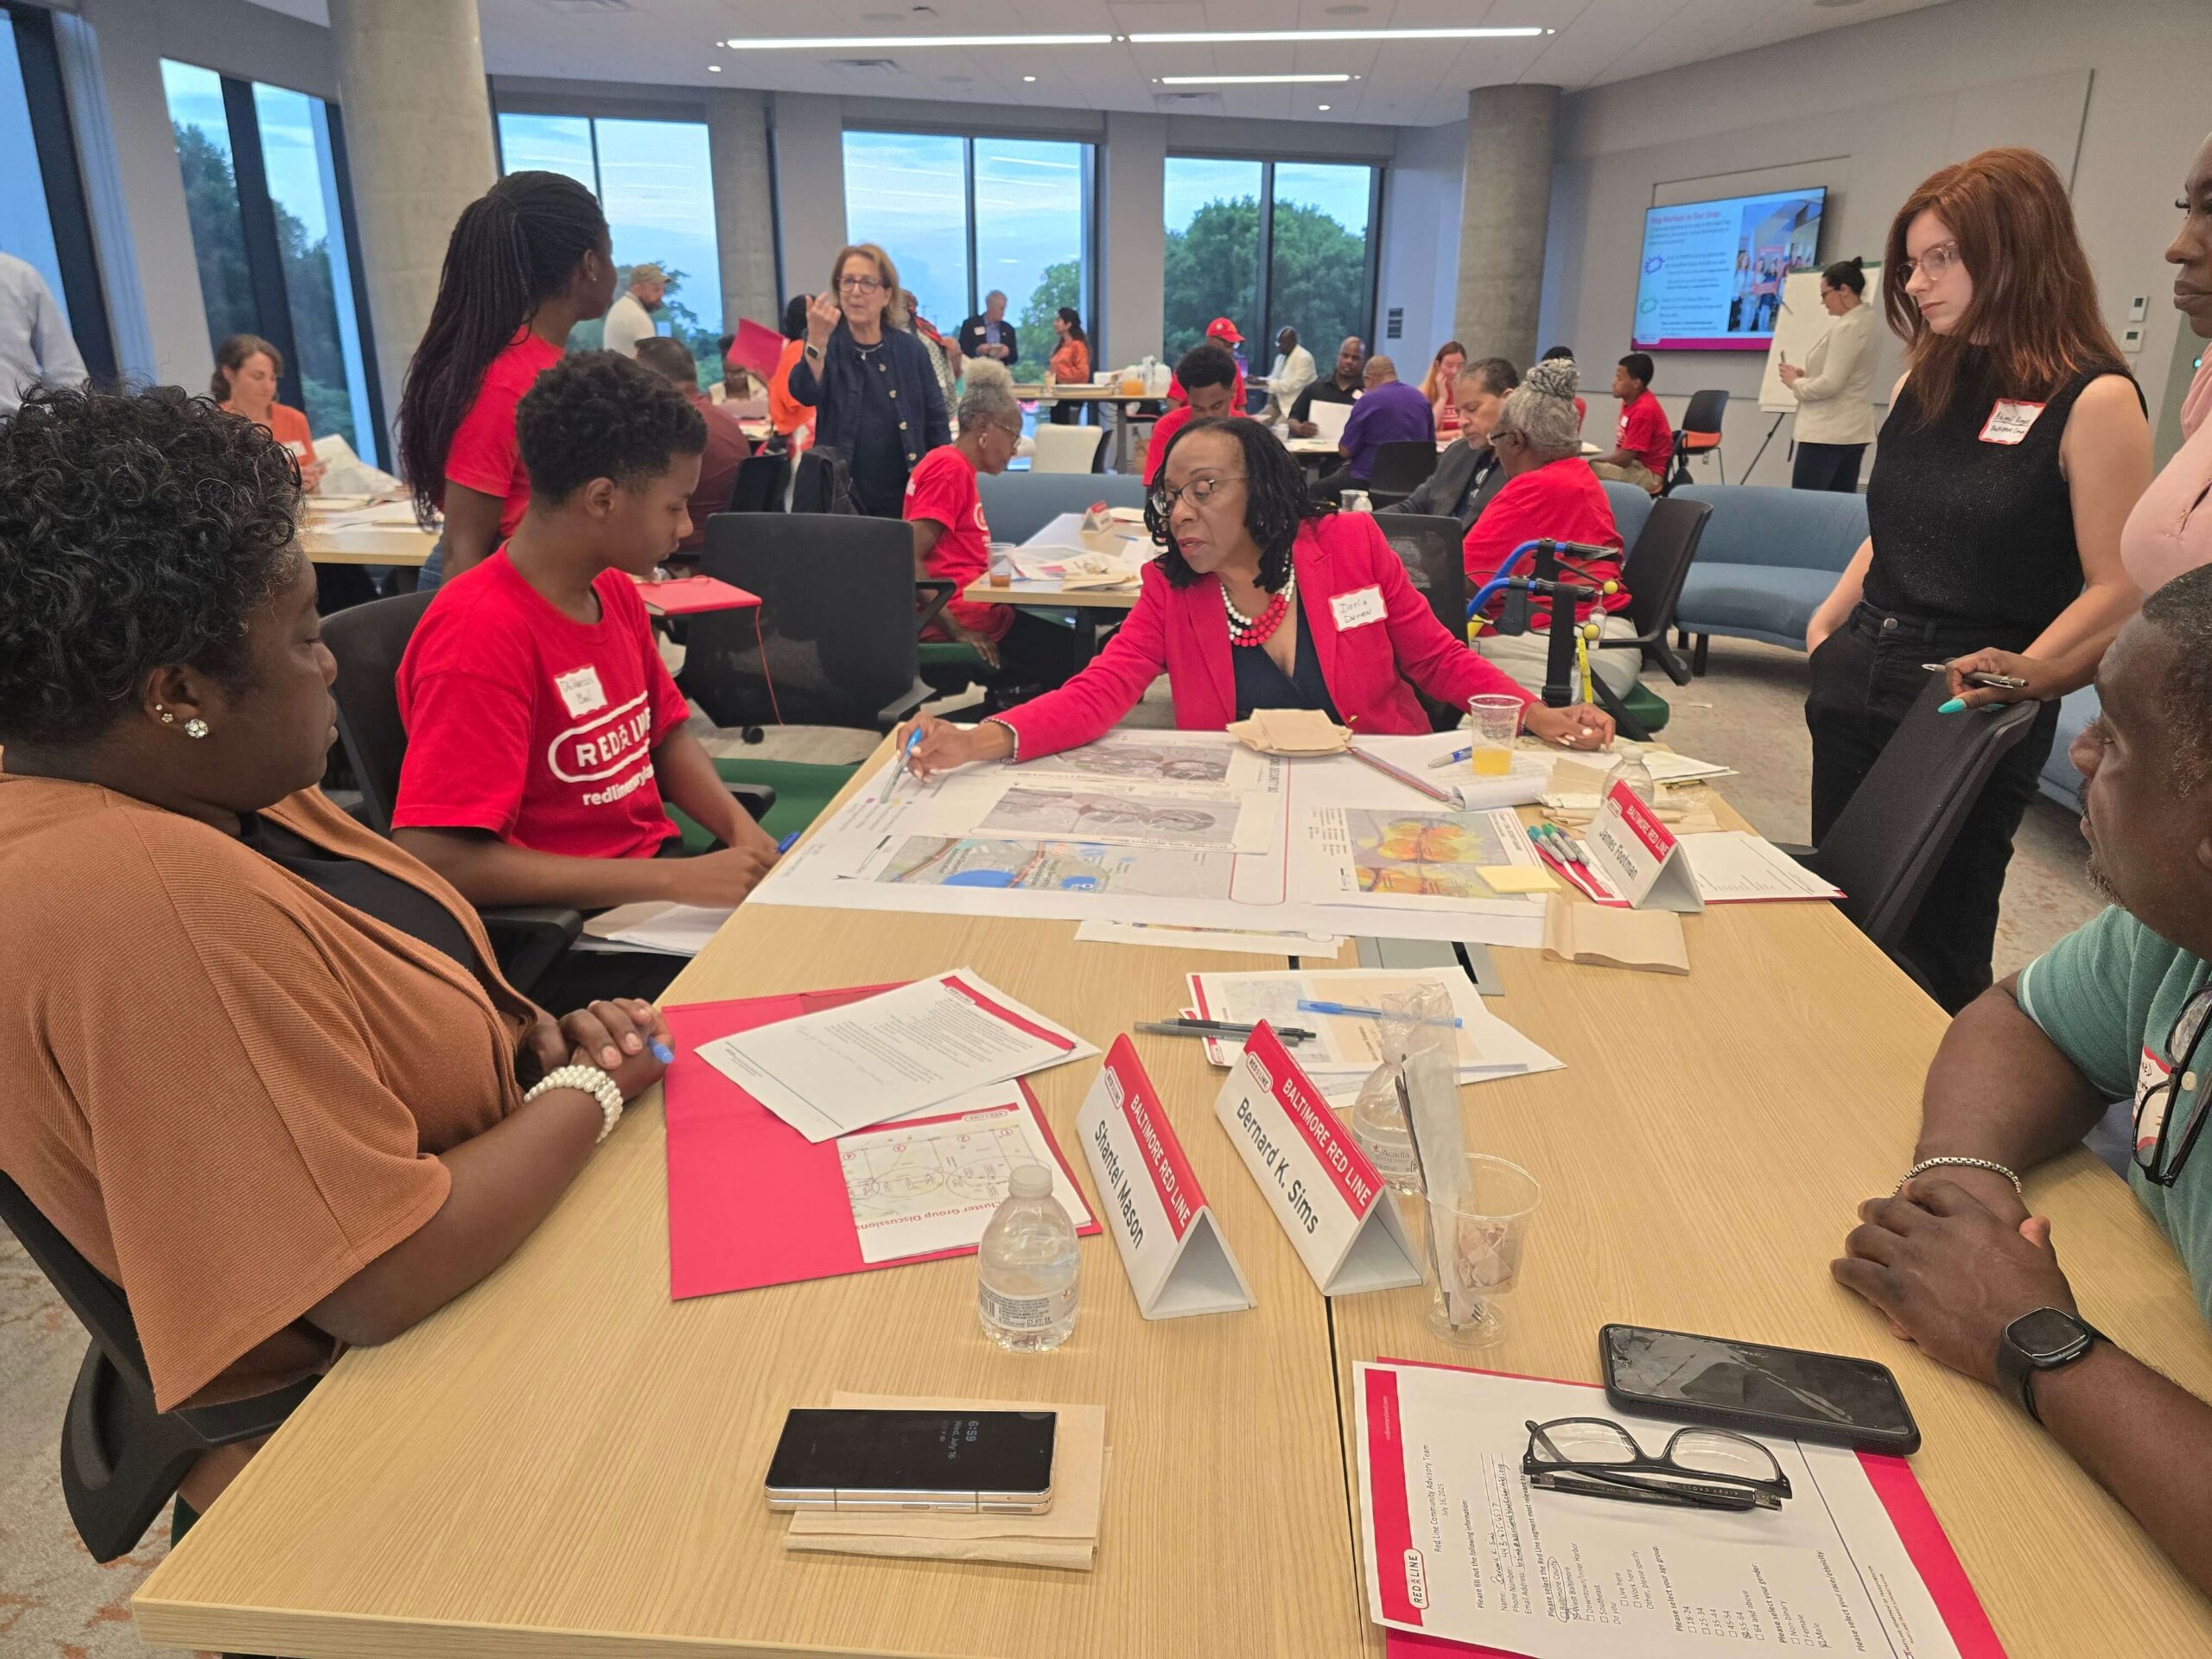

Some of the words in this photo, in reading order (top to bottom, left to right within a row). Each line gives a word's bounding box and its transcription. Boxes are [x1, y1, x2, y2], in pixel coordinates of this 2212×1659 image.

[1340, 599, 1367, 613] Doris
[575, 731, 621, 767] RED
[1627, 804, 1651, 835] BALTIMORE
[1647, 828, 1659, 844] RED
[1655, 838, 1669, 856] LINE
[1599, 826, 1617, 852] James
[1613, 843, 1638, 881] Footman
[1249, 1058, 1259, 1072] RED
[1258, 1073, 1268, 1088] LINE
[1282, 1078, 1331, 1148] BALTIMORE
[1326, 1140, 1348, 1173] RED
[1344, 1166, 1372, 1207] LINE
[1130, 1094, 1164, 1166] BALTIMORE
[1159, 1157, 1176, 1192] RED
[1170, 1185, 1191, 1228] LINE
[1382, 1149, 1410, 1159] Acadia
[1236, 1097, 1281, 1167] Bernard
[1274, 1157, 1290, 1188] K.
[1287, 1179, 1319, 1234] Sims
[1095, 1120, 1125, 1190] Shantel
[1116, 1179, 1144, 1249] Mason
[855, 1215, 922, 1230] Discussions
[925, 1208, 960, 1220] Group
[951, 1420, 963, 1436] Wed,
[965, 1421, 979, 1442] 6:59
[948, 1437, 959, 1450] July
[1425, 1462, 1433, 1491] Advisory
[1428, 1491, 1438, 1525] Community
[1462, 1500, 1472, 1532] information:
[1529, 1518, 1540, 1541] segment
[1467, 1532, 1477, 1556] following
[1572, 1542, 1580, 1561] Harbor
[1630, 1549, 1643, 1570] specify:
[1652, 1545, 1663, 1564] group:
[1408, 1554, 1421, 1578] LINE
[1539, 1566, 1548, 1576] the
[1551, 1560, 1560, 1580] County
[1657, 1564, 1668, 1574] age
[1751, 1561, 1767, 1586] gender:
[1816, 1549, 1840, 1592] race/ethnicity:
[1507, 1567, 1516, 1592] Number:
[1519, 1571, 1529, 1596] Address:
[1541, 1577, 1551, 1594] select
[1565, 1567, 1576, 1595] Baltimore
[1578, 1562, 1593, 1614] Downtown/Inner
[1615, 1572, 1624, 1586] here
[1638, 1571, 1649, 1589] please
[1662, 1574, 1672, 1589] your
[1412, 1586, 1423, 1604] RED
[1476, 1588, 1485, 1609] Please
[1500, 1591, 1510, 1611] Name:
[1556, 1581, 1567, 1611] Baltimore
[1593, 1584, 1607, 1616] Southeast
[1629, 1584, 1640, 1600] Work
[1643, 1590, 1654, 1610] Other,
[1666, 1590, 1677, 1609] select
[1742, 1590, 1753, 1609] above
[1761, 1585, 1772, 1599] your
[1836, 1592, 1848, 1608] your
[1510, 1592, 1520, 1613] Phone
[1547, 1596, 1555, 1618] Please
[1570, 1596, 1580, 1612] West
[1611, 1601, 1619, 1614] you
[1766, 1600, 1779, 1620] select
[1613, 1615, 1621, 1624] Do
[1672, 1610, 1683, 1632] Please
[1682, 1605, 1694, 1624] 18-24
[1696, 1607, 1708, 1626] 25-34
[1709, 1609, 1722, 1628] 35-44
[1722, 1611, 1734, 1630] 45-54
[1736, 1611, 1748, 1631] 55-64
[1747, 1609, 1758, 1623] and
[1779, 1600, 1797, 1637] Non-binary
[1842, 1608, 1856, 1629] select
[1885, 1603, 1900, 1630] DEPARTMENT
[1752, 1624, 1762, 1633] 64
[1774, 1622, 1787, 1643] Please
[1797, 1614, 1811, 1637] Female
[1813, 1623, 1824, 1640] Male
[1852, 1630, 1866, 1652] Please
